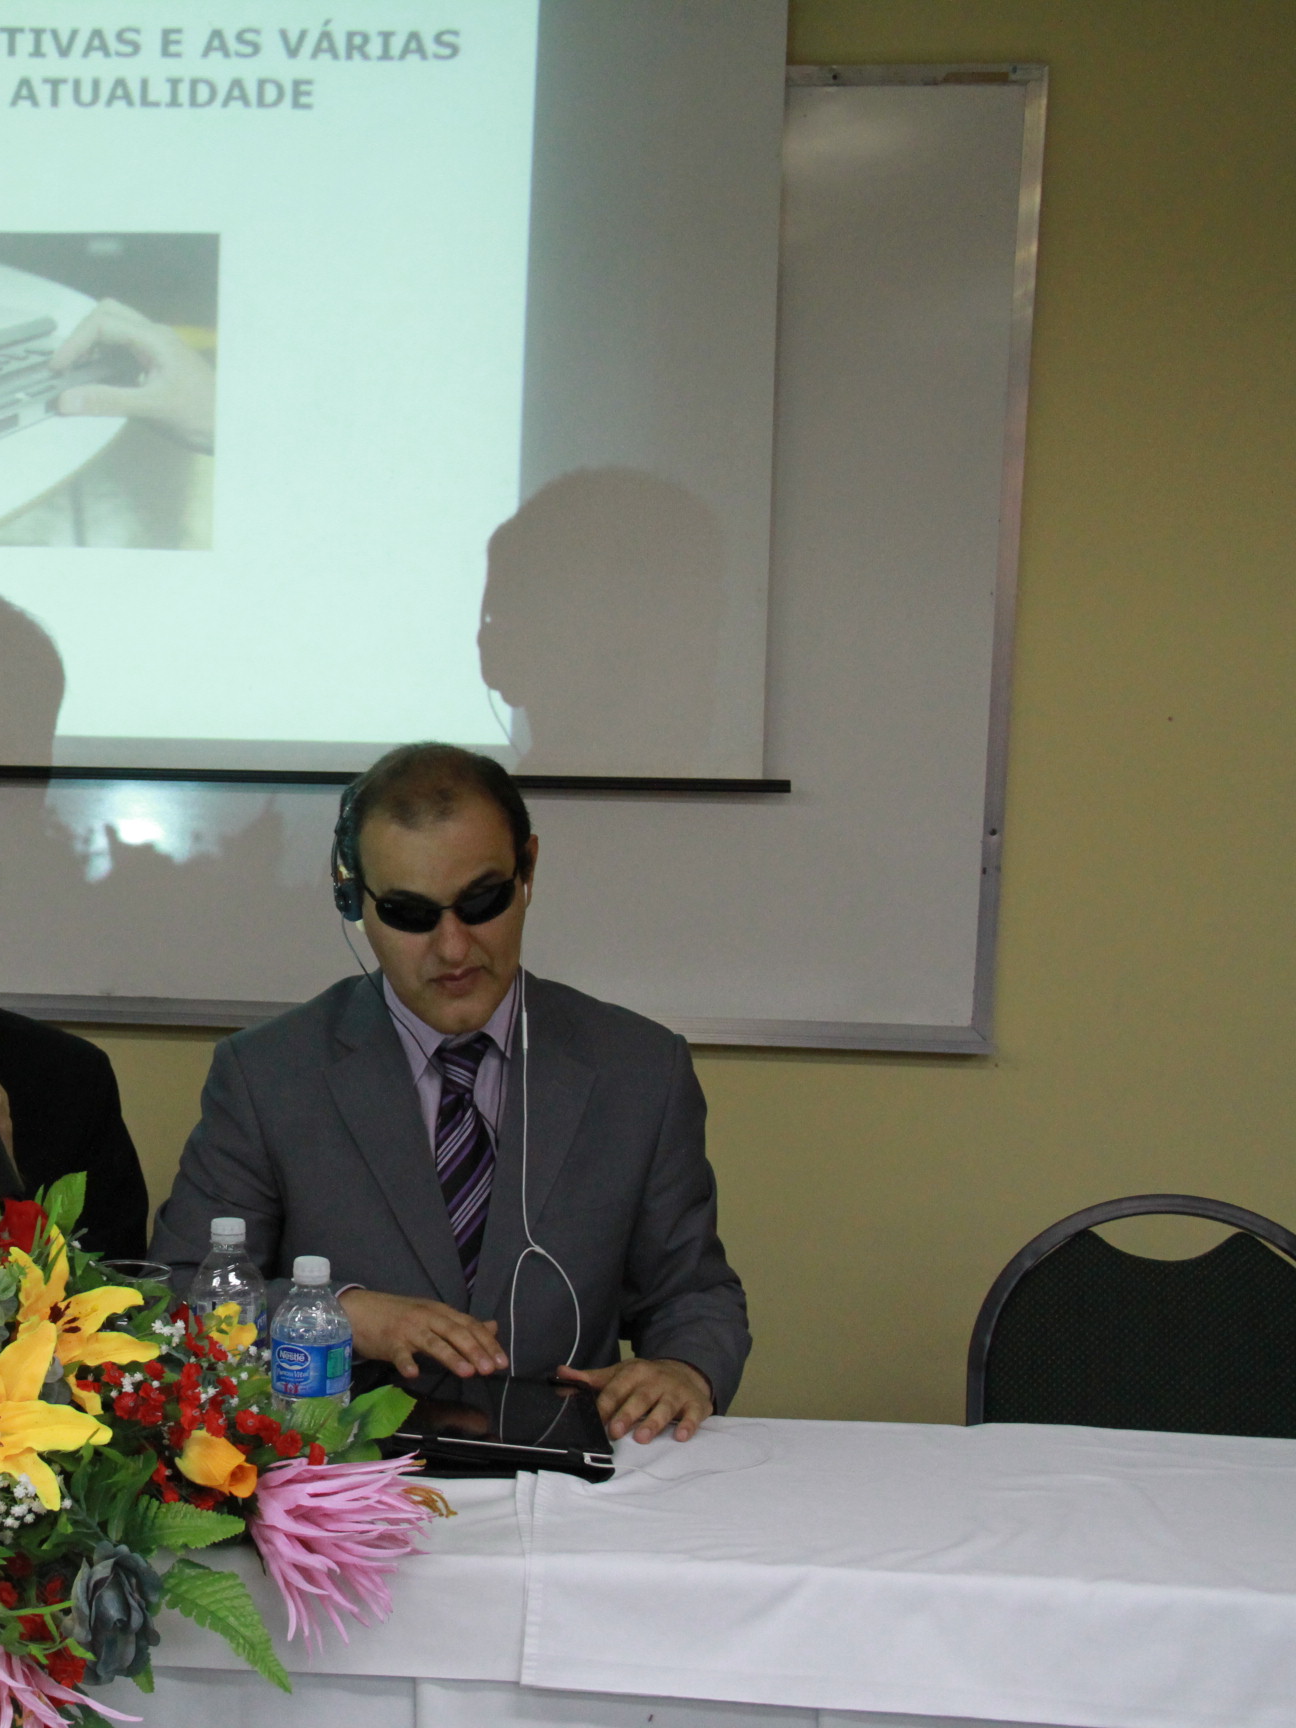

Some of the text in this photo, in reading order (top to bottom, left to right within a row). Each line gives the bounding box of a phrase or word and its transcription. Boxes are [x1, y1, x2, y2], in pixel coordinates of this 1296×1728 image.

[160, 27, 184, 59] E
[200, 28, 262, 59] AS
[278, 19, 461, 62] VÁRIAS
[9, 76, 314, 111] ATUALIDADE
